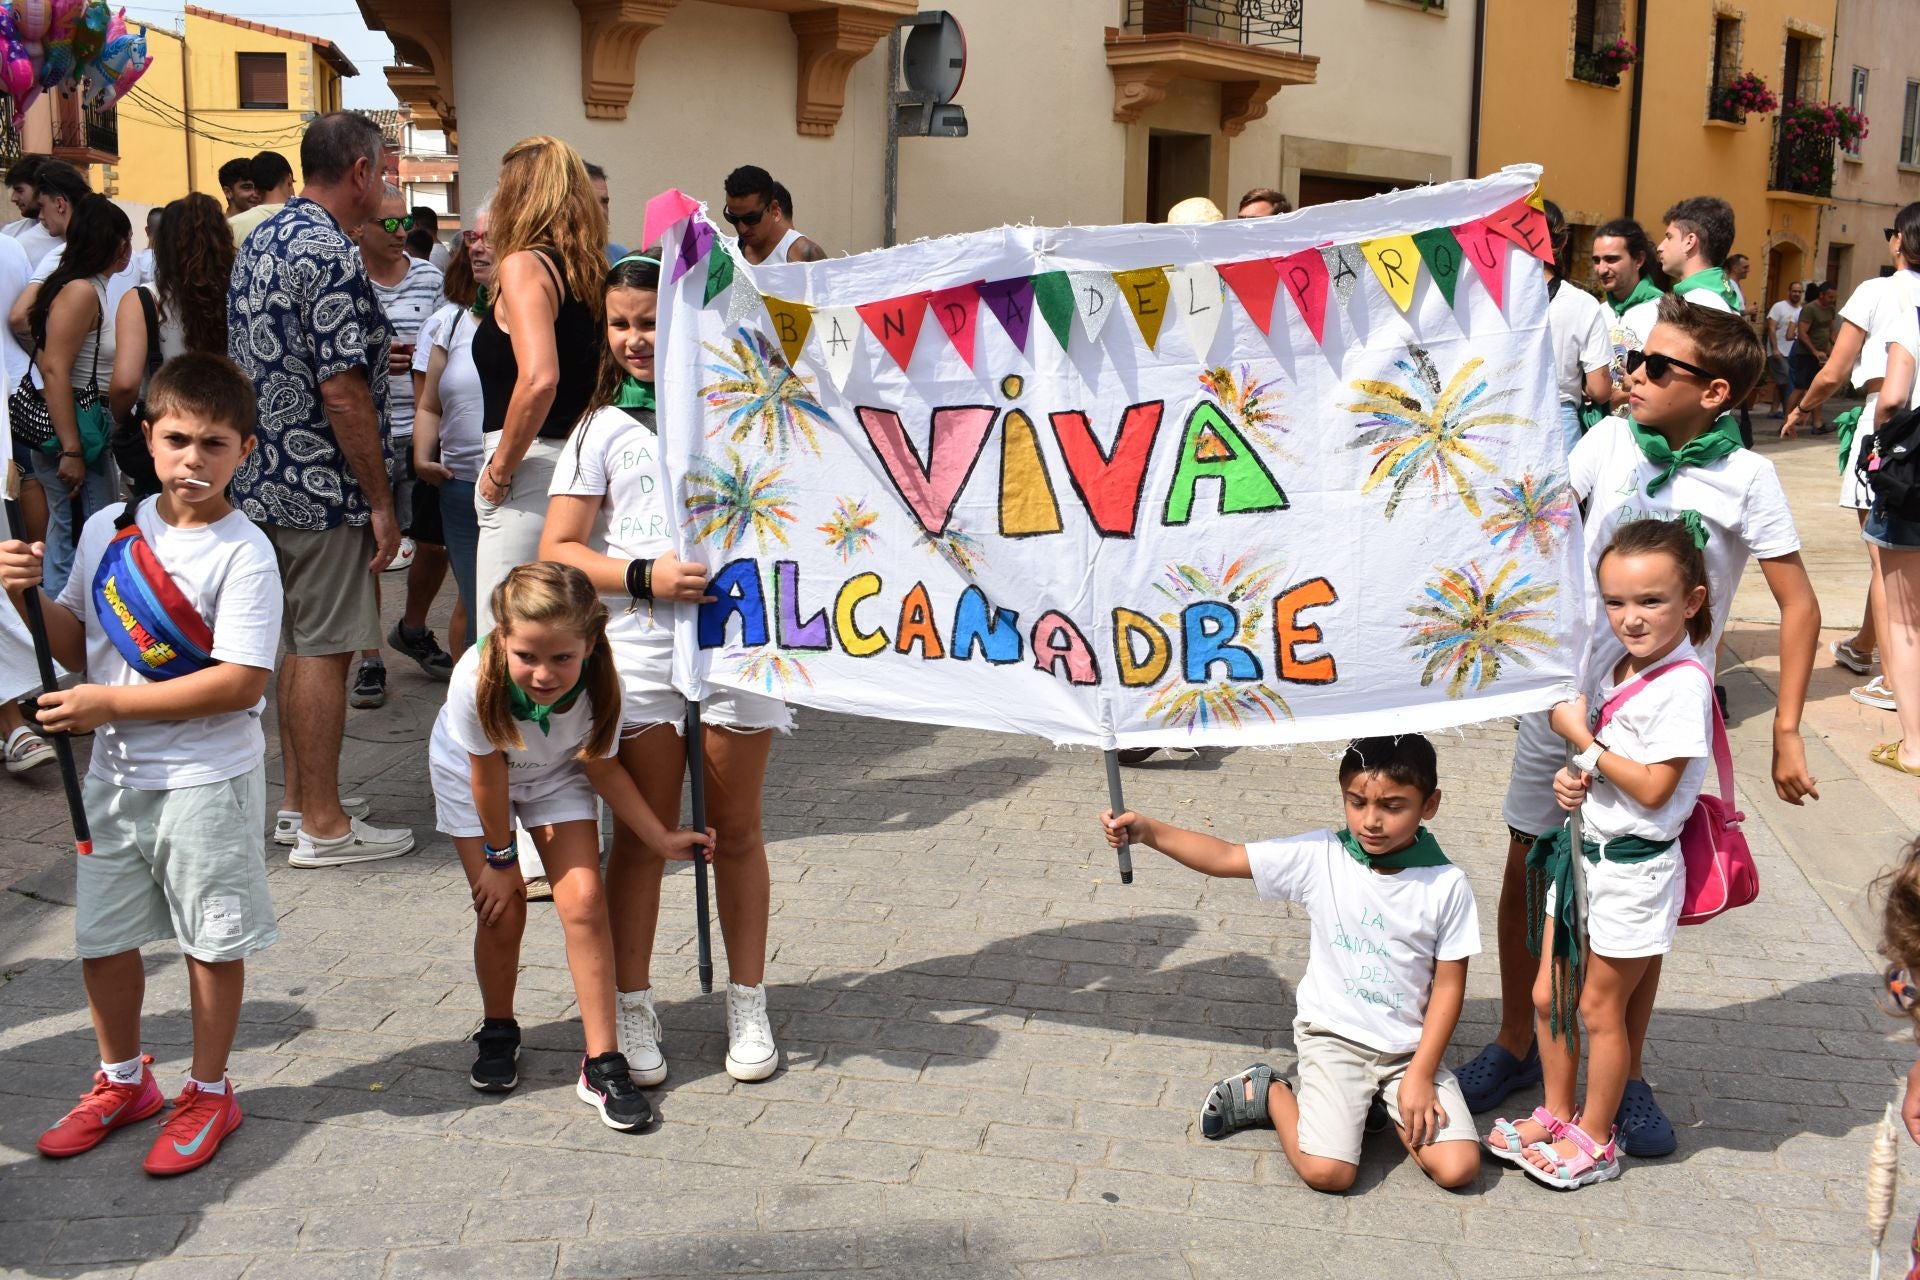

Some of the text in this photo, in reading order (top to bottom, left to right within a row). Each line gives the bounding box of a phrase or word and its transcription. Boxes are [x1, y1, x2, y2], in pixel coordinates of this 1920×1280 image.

[774, 290, 1025, 357] BANDA
[1089, 277, 1211, 318] DEL
[1288, 211, 1545, 313] PARQUE
[103, 575, 157, 653] DRAGON BALL
[698, 557, 1338, 687] ALCANADRE
[1360, 906, 1385, 932] LA
[1359, 965, 1395, 984] DEL
